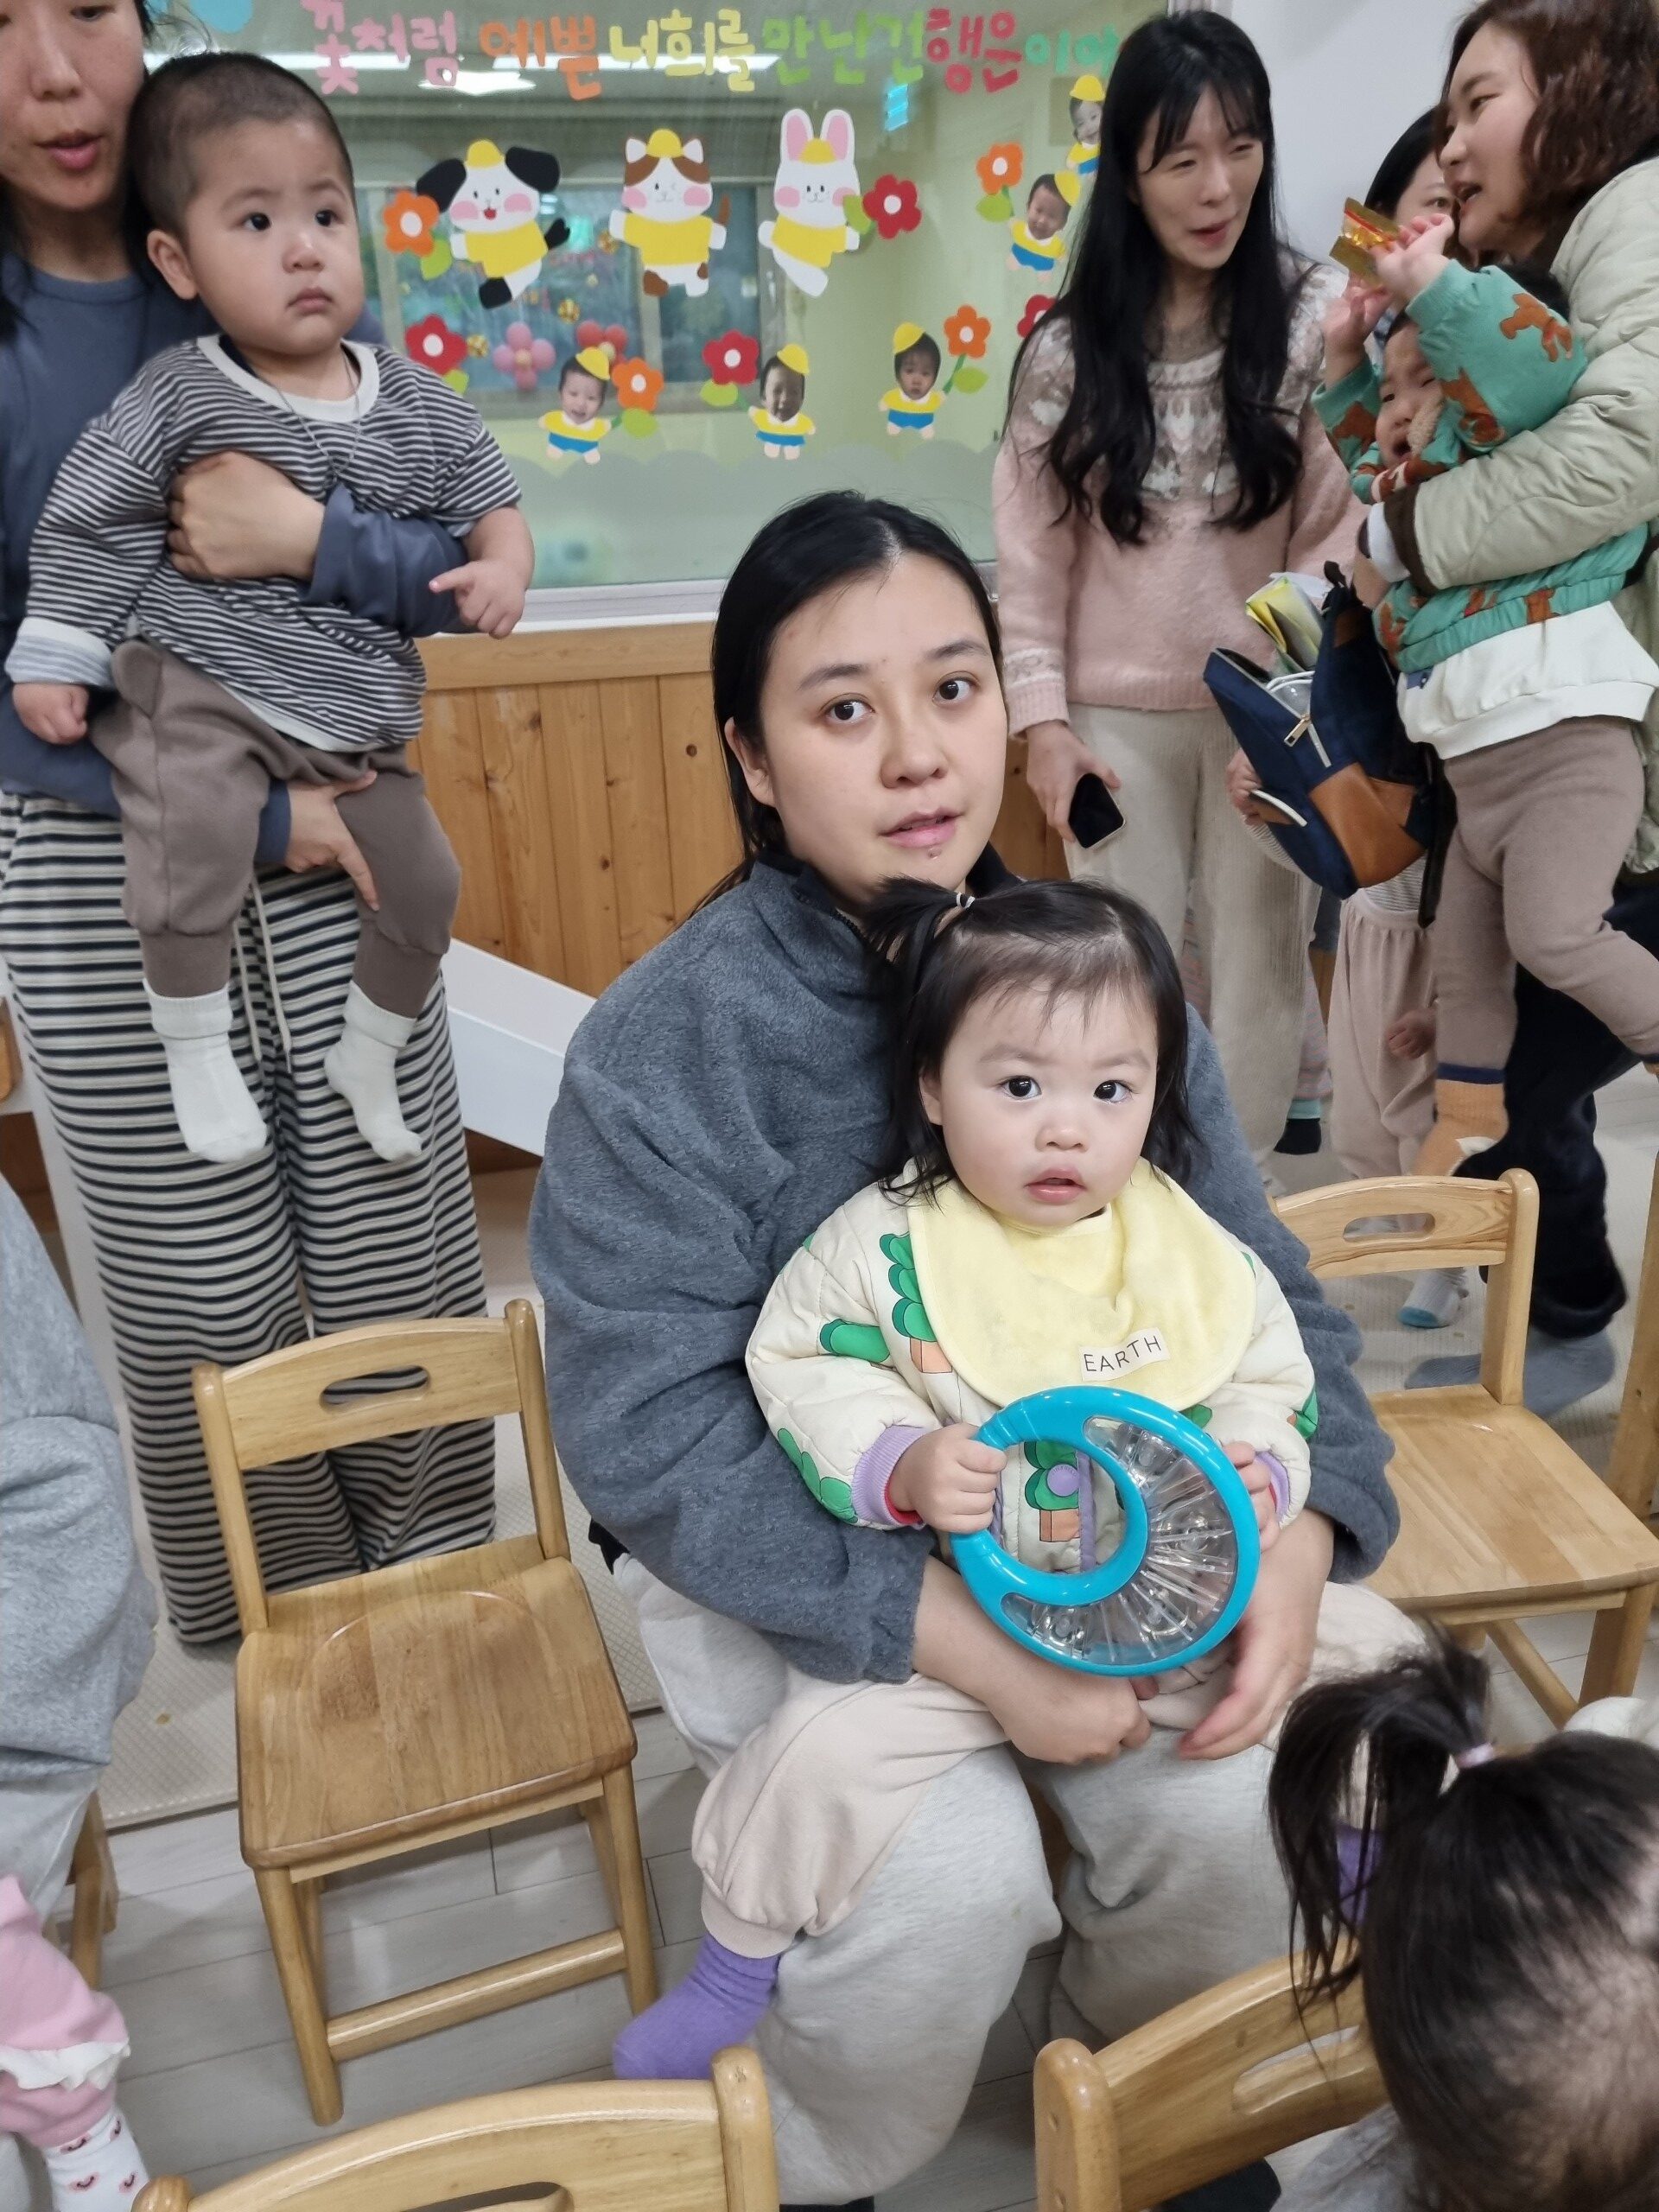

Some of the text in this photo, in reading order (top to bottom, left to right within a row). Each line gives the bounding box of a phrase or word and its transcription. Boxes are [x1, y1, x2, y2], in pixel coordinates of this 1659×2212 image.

[300, 0, 460, 94] 꽃처럼
[480, 16, 602, 101] 예쁜
[609, 9, 756, 92] 너희를
[1084, 1336, 1161, 1372] EARTH
